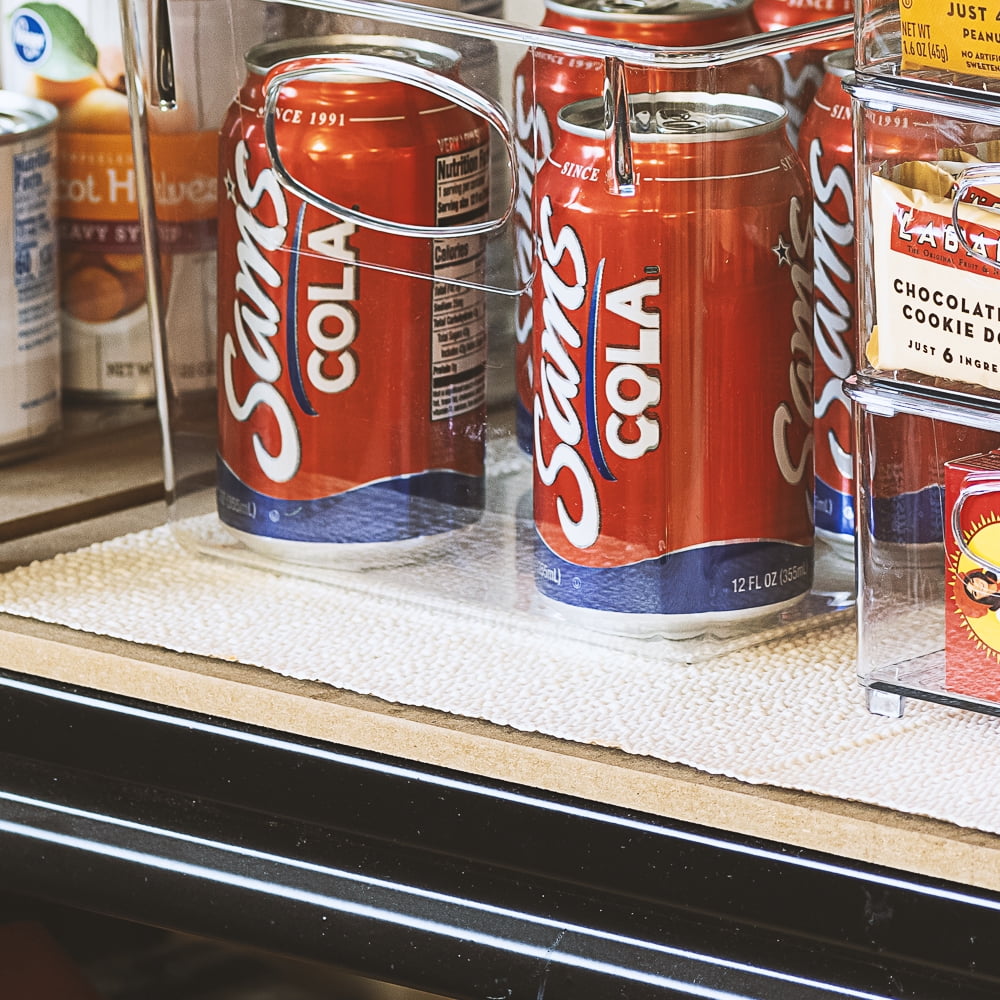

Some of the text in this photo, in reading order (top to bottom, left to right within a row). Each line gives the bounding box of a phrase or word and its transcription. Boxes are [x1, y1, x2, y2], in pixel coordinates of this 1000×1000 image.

[947, 2, 987, 21] JUST
[902, 22, 931, 39] NET WT
[903, 40, 949, 63] 1.6 OZ (45g)
[961, 50, 973, 58] NO
[309, 112, 345, 126] 1991
[438, 155, 478, 180] Nutrition
[561, 161, 600, 182] SINCE
[307, 220, 359, 393] COLA
[903, 305, 974, 338] COOKIE
[908, 340, 936, 356] JUST
[943, 348, 953, 363] 6
[606, 276, 662, 459] COLA
[732, 572, 777, 592] 12 FL OZ
